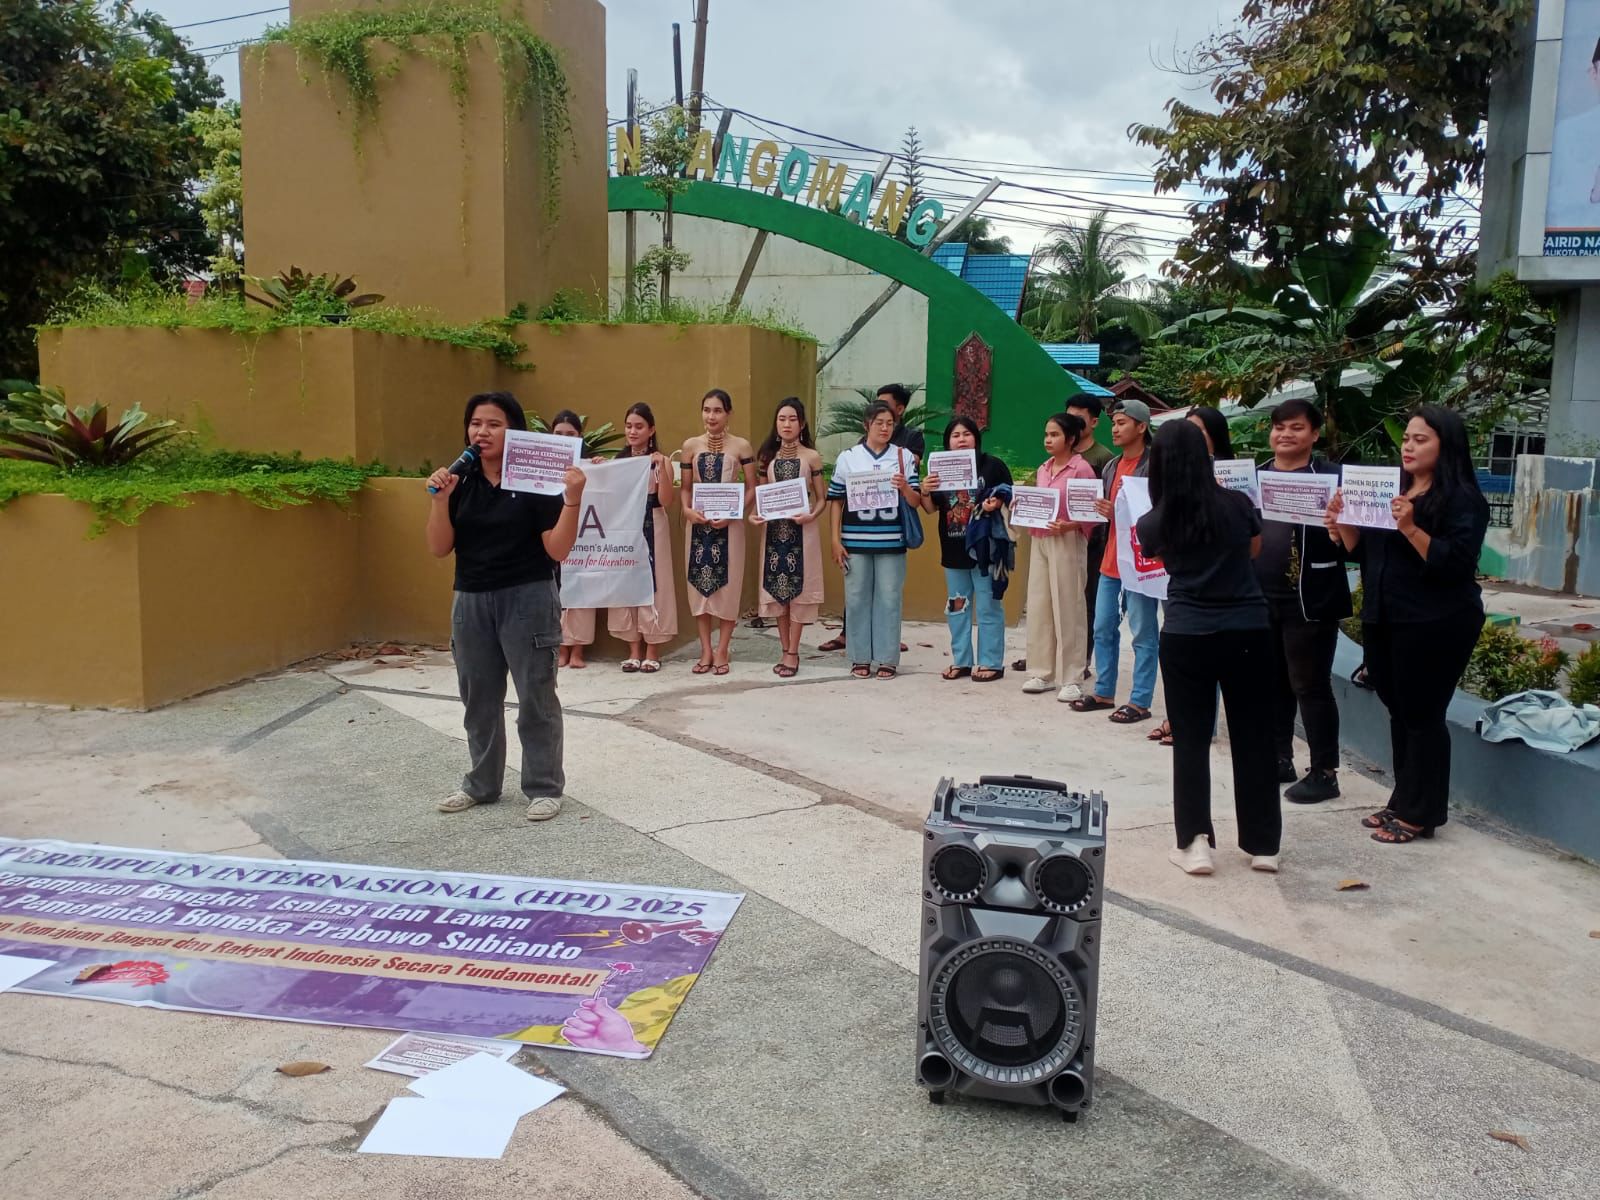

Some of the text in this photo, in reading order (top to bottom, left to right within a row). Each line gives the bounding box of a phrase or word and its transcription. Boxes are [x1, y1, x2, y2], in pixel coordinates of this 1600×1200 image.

[1544, 236, 1581, 247] AIRID
[1544, 249, 1577, 257] ALIKOTA
[512, 447, 540, 457] HENTIKAN
[539, 470, 565, 478] PEREMPU
[1343, 479, 1395, 489] WOMEN RISE FOR
[570, 544, 634, 553] omen's Alliance
[561, 558, 584, 566] omen
[585, 553, 598, 568] for
[0, 846, 708, 917] PEREMPUAN INTERNASIONAL (HPI) 2025
[0, 871, 531, 931] Perempuan Bangkit, Isolasi dan Lawan
[2, 893, 583, 960] Pemerintah Boneka Prabowo Subianto
[10, 921, 104, 942] Kemajuan
[101, 930, 173, 948] Bangsa
[172, 937, 210, 952] dan
[211, 940, 284, 959] Rakyat
[283, 947, 380, 969] Indonesia
[382, 956, 453, 976] Secara
[455, 963, 598, 988] Fundamental!
